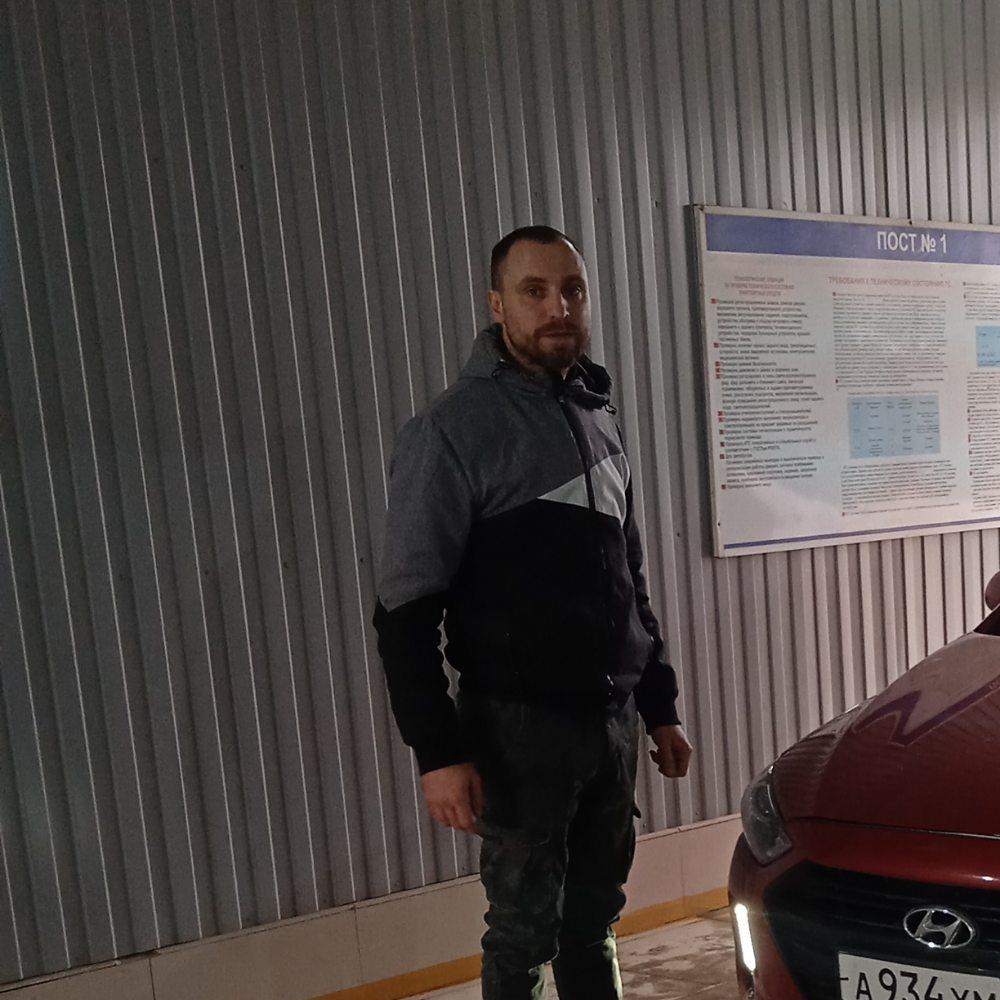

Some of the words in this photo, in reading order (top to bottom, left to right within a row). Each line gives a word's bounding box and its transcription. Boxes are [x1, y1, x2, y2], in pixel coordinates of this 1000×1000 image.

[877, 231, 917, 252] ПОСТ
[921, 233, 936, 253] №
[940, 233, 947, 253] 1
